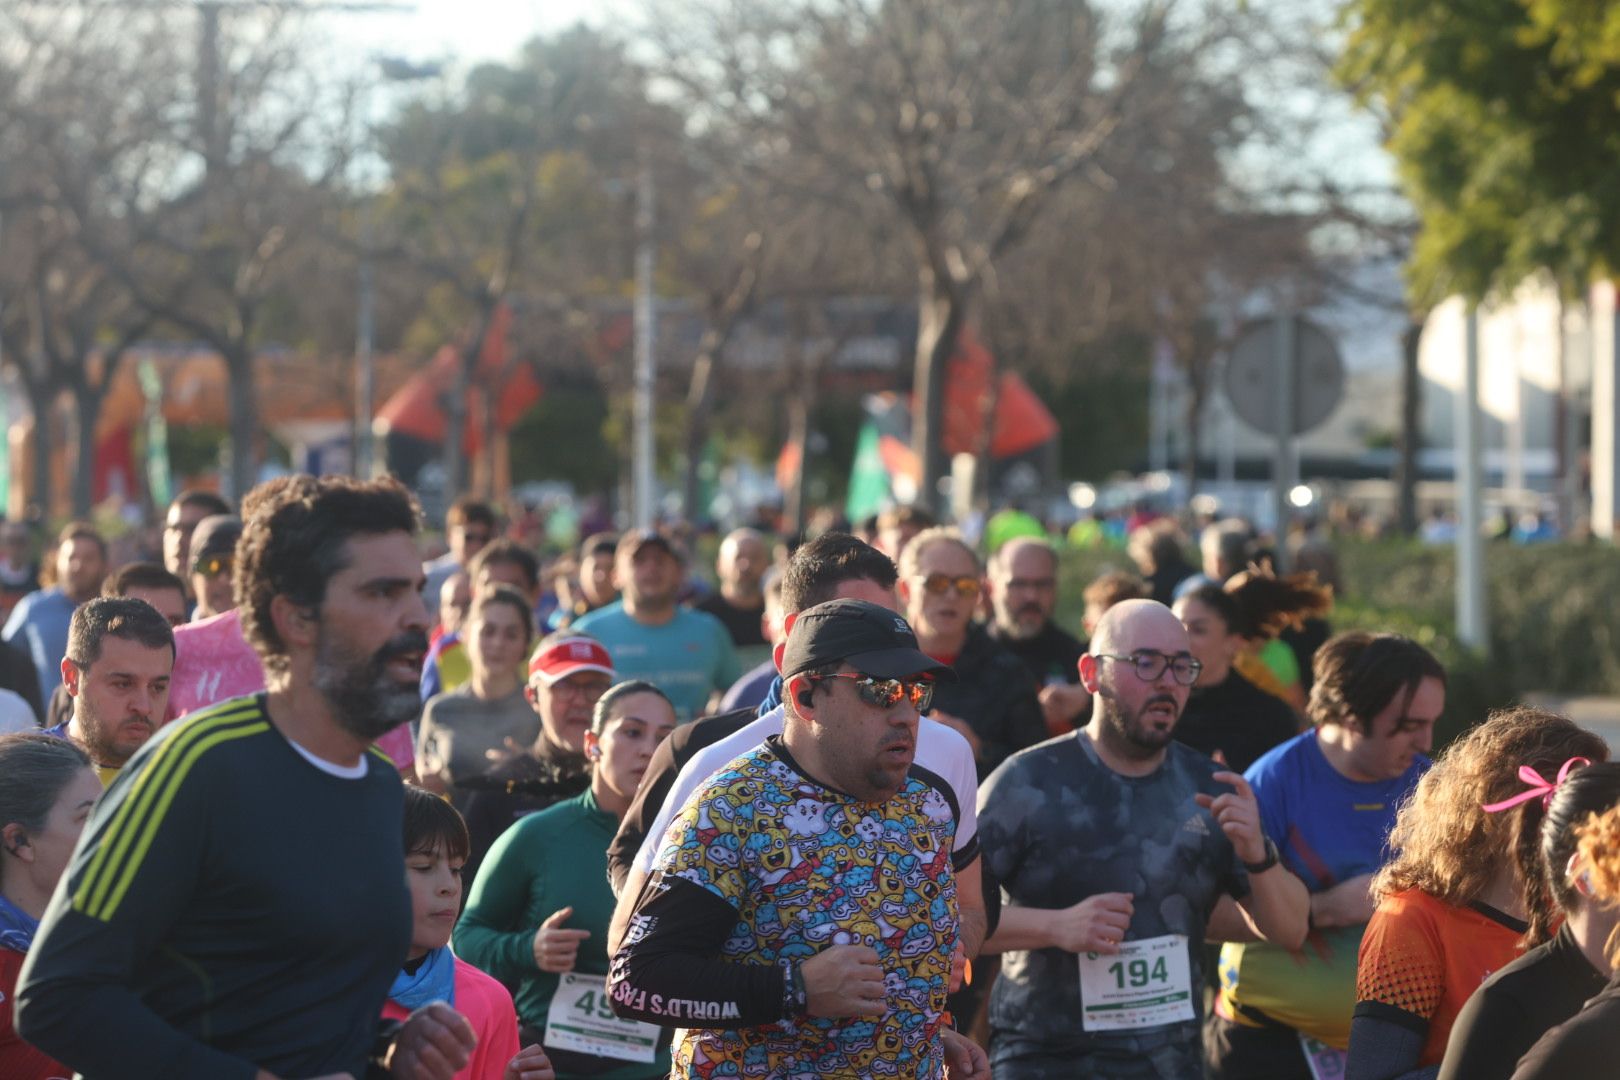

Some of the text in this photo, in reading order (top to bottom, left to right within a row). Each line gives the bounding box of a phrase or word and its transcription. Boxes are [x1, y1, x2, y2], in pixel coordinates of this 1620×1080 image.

[1108, 955, 1169, 989] 194
[574, 989, 639, 1025] 49
[651, 994, 742, 1020] WORLD'S
